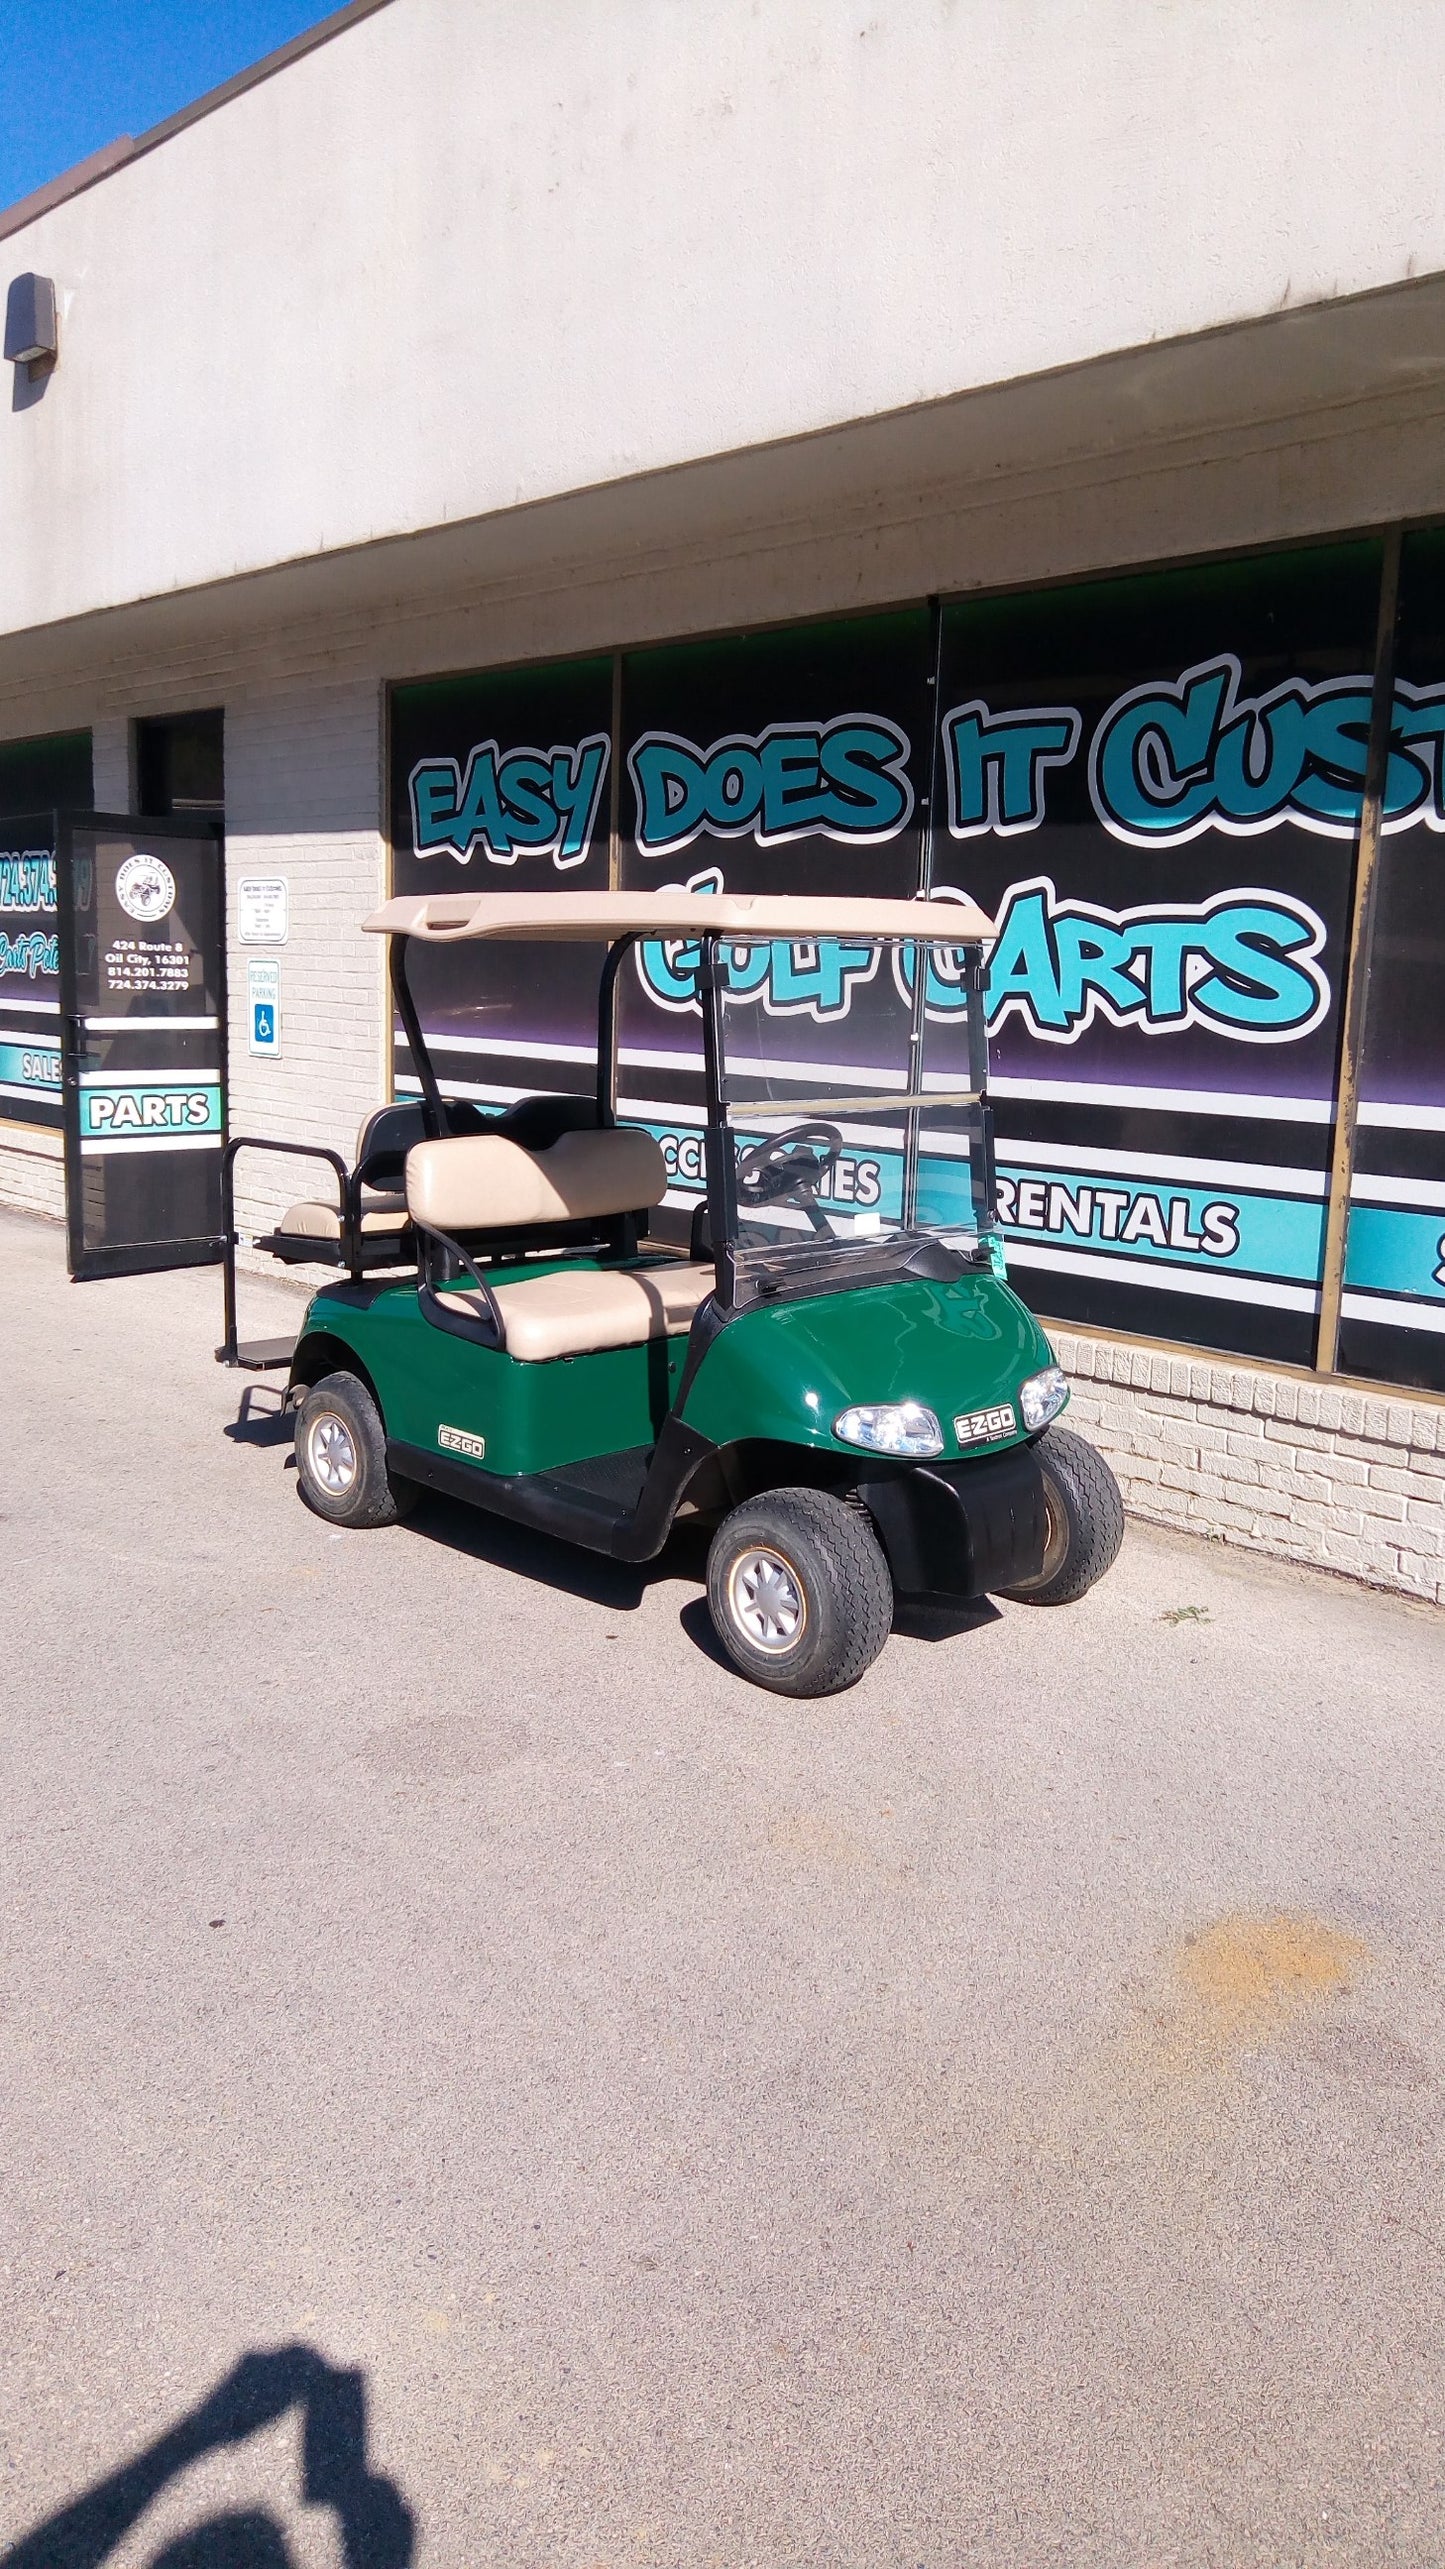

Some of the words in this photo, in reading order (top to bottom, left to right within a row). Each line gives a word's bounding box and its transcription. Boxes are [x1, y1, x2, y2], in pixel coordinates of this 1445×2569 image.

[410, 738, 608, 862] EASY
[632, 720, 906, 850] DOES
[948, 708, 1074, 830] IT
[112, 940, 136, 951] 424
[138, 941, 173, 952] Route
[174, 942, 184, 953] 8
[104, 953, 124, 963] Oil
[126, 953, 152, 966] City,
[154, 955, 190, 965] 16301
[107, 966, 189, 978] 814.201.7883
[107, 979, 190, 991] 724.374.3279
[22, 1053, 62, 1083] SALE
[89, 1093, 210, 1129] PARTS
[995, 1180, 1240, 1257] RENTALS
